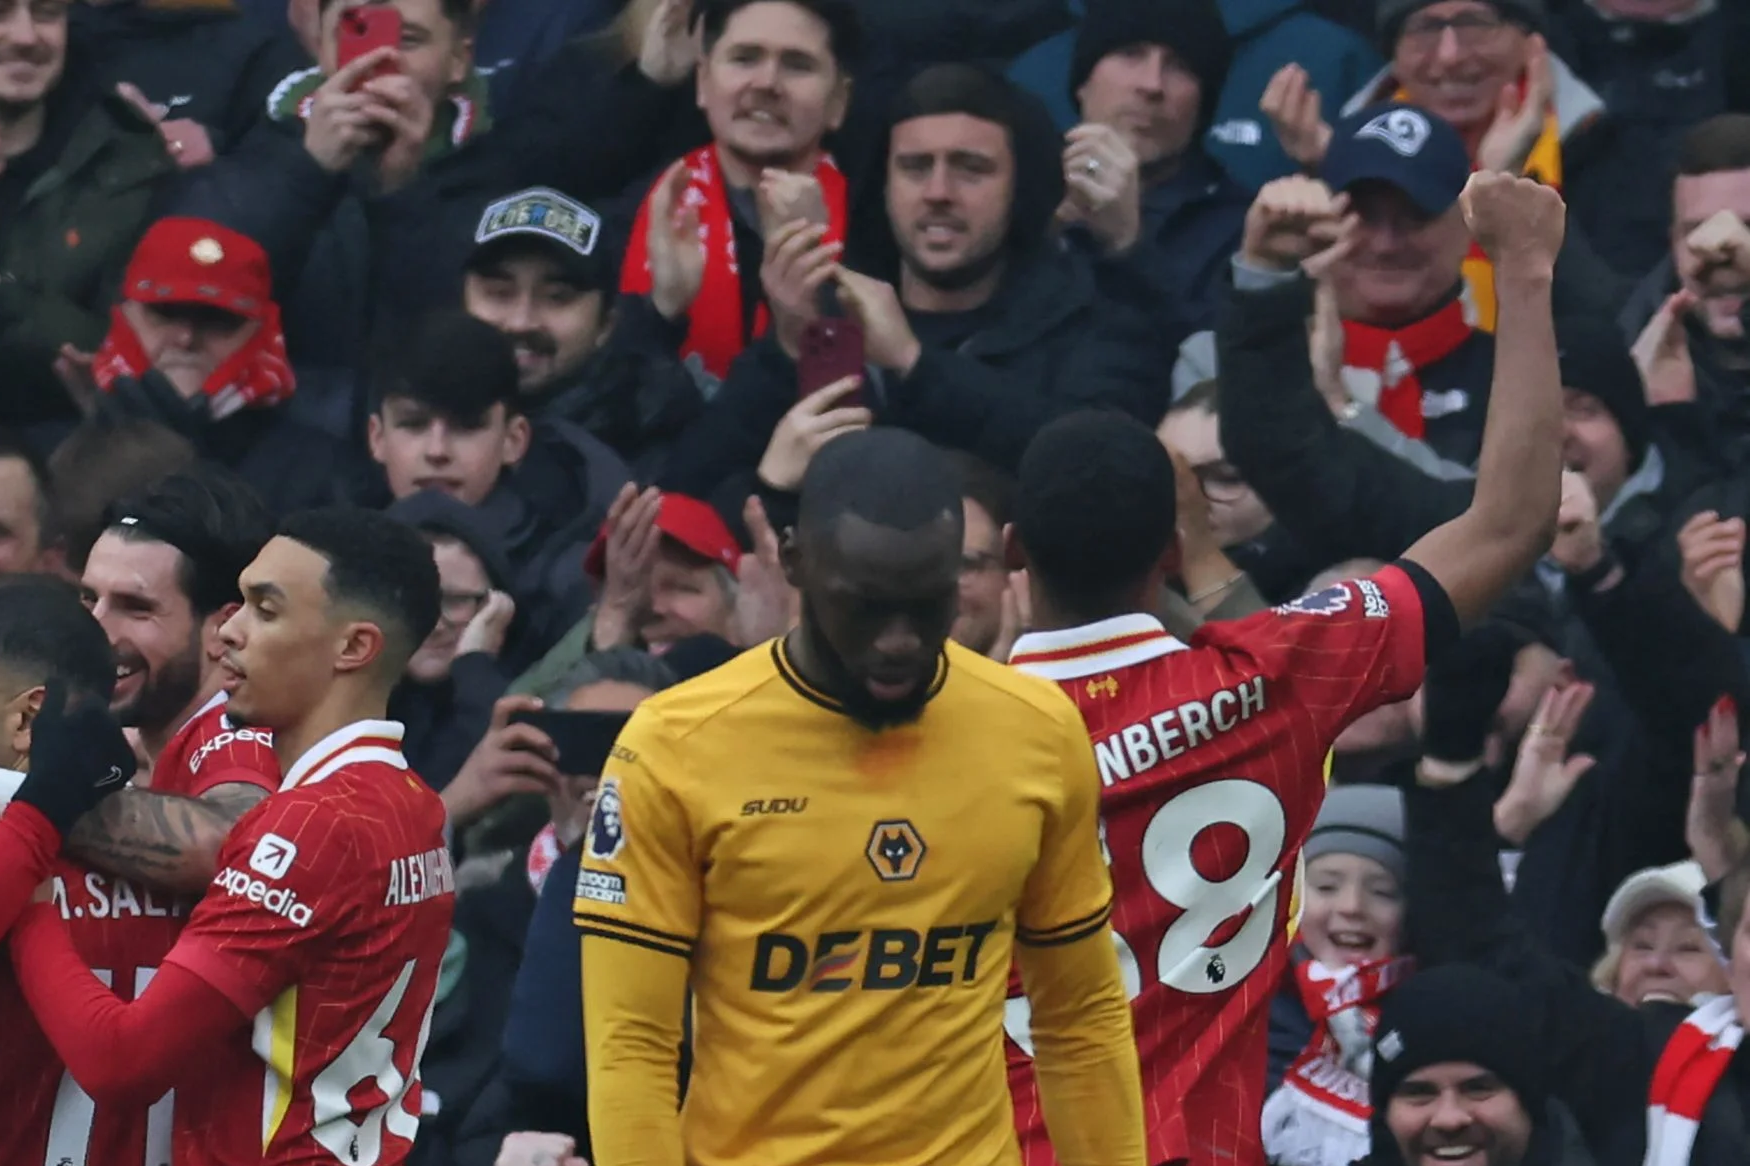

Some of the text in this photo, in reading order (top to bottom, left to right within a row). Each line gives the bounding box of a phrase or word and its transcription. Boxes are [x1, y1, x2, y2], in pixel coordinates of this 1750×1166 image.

[189, 729, 273, 775] Exped
[1094, 676, 1265, 787] NBERCH
[740, 797, 808, 816] SUDU
[750, 919, 999, 993] DEBET
